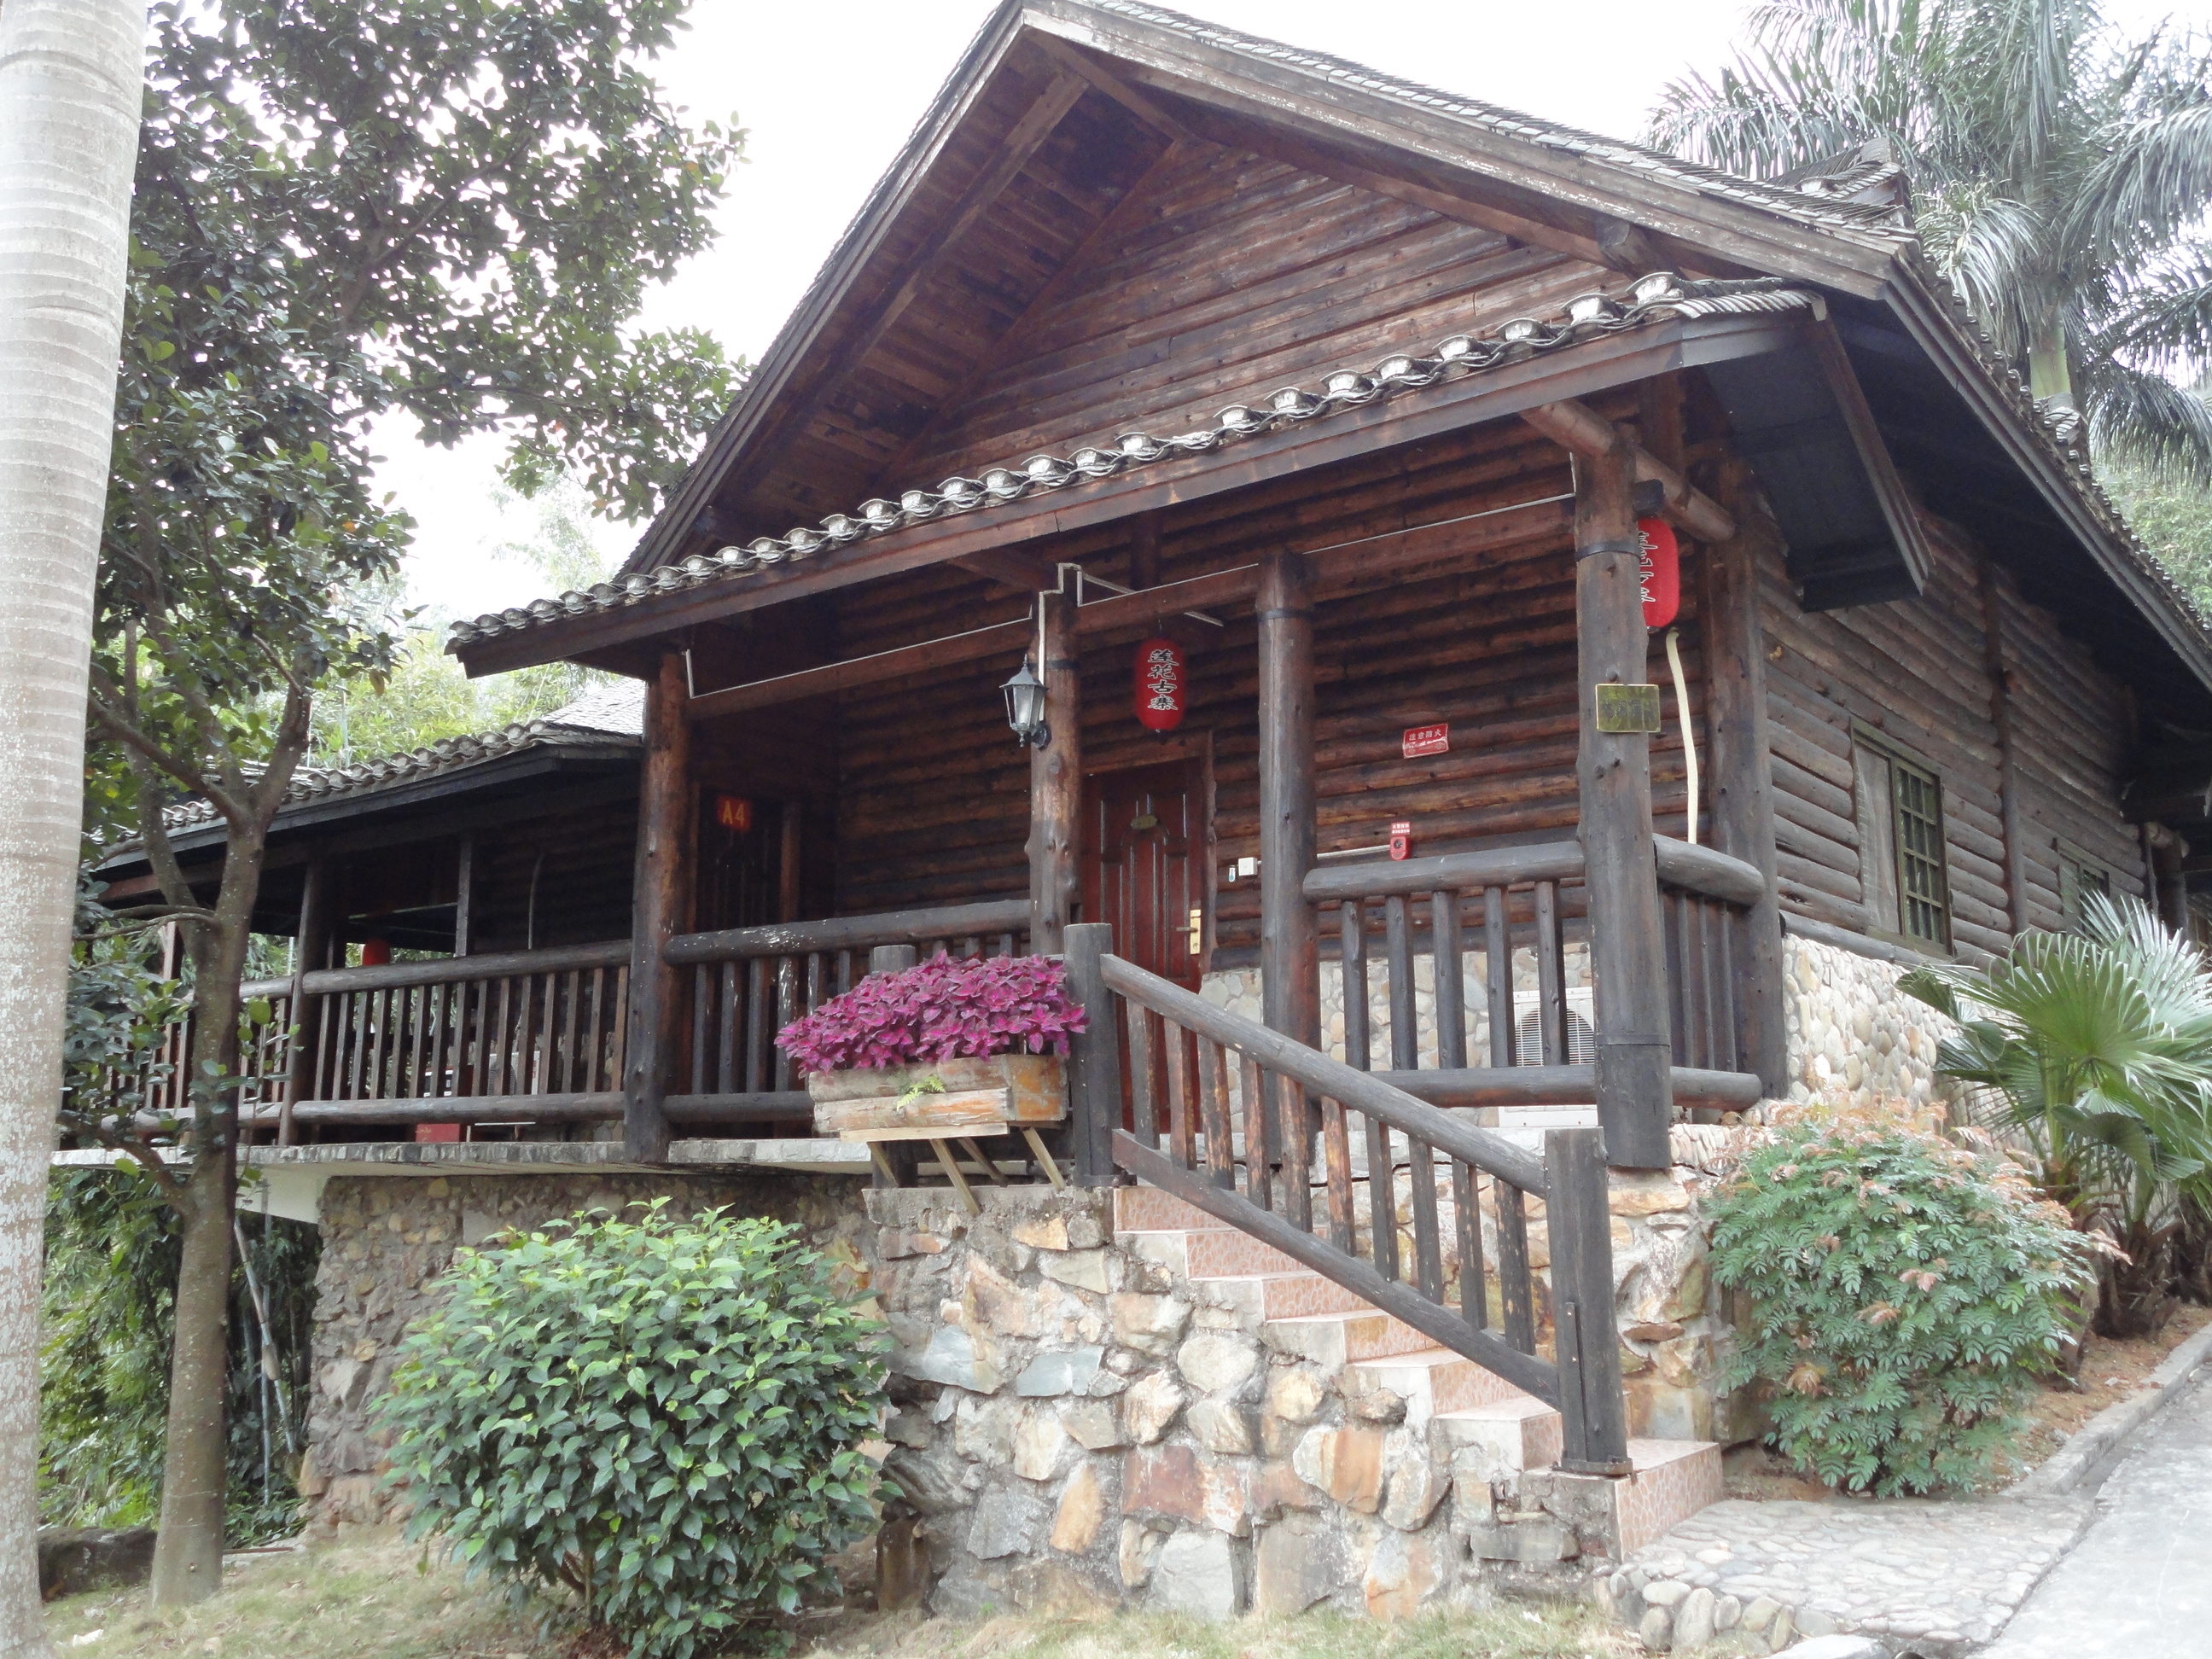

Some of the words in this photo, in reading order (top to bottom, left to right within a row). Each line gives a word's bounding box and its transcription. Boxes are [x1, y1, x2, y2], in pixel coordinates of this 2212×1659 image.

[1408, 728, 1442, 741] 注意防火
[722, 800, 745, 827] A4
